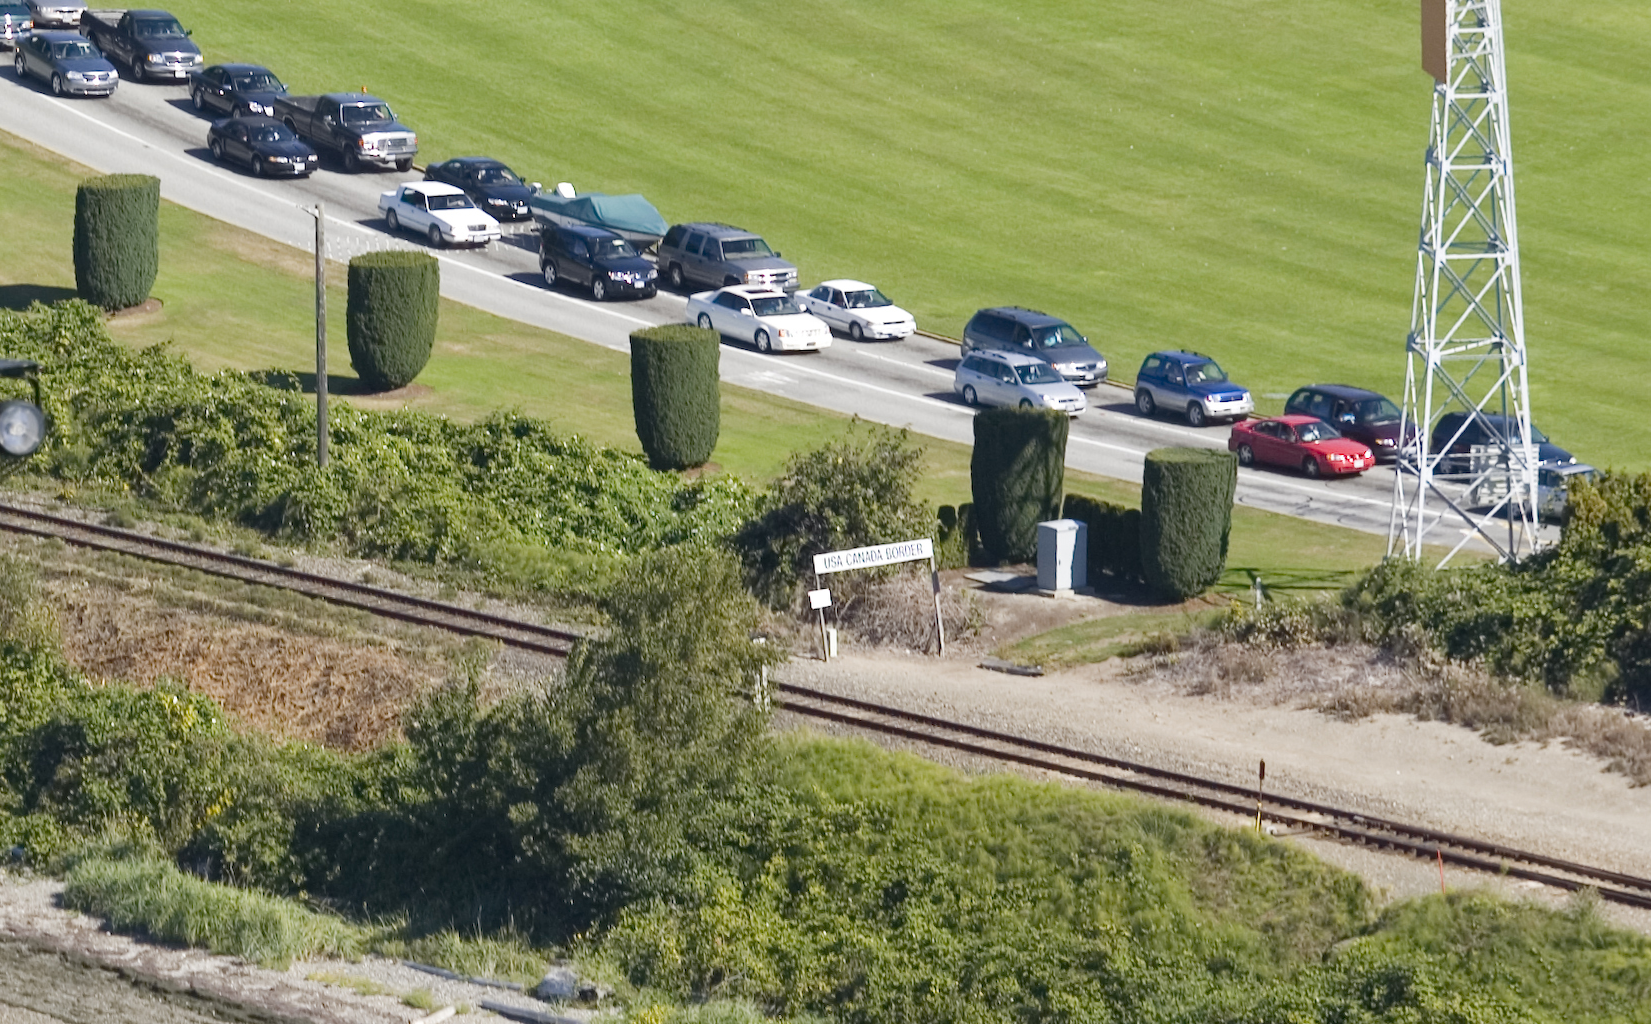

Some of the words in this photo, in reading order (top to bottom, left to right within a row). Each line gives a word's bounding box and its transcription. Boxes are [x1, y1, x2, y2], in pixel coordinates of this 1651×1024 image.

[823, 555, 843, 569] USA
[845, 549, 883, 566] CANADA
[885, 542, 923, 560] BORDER
